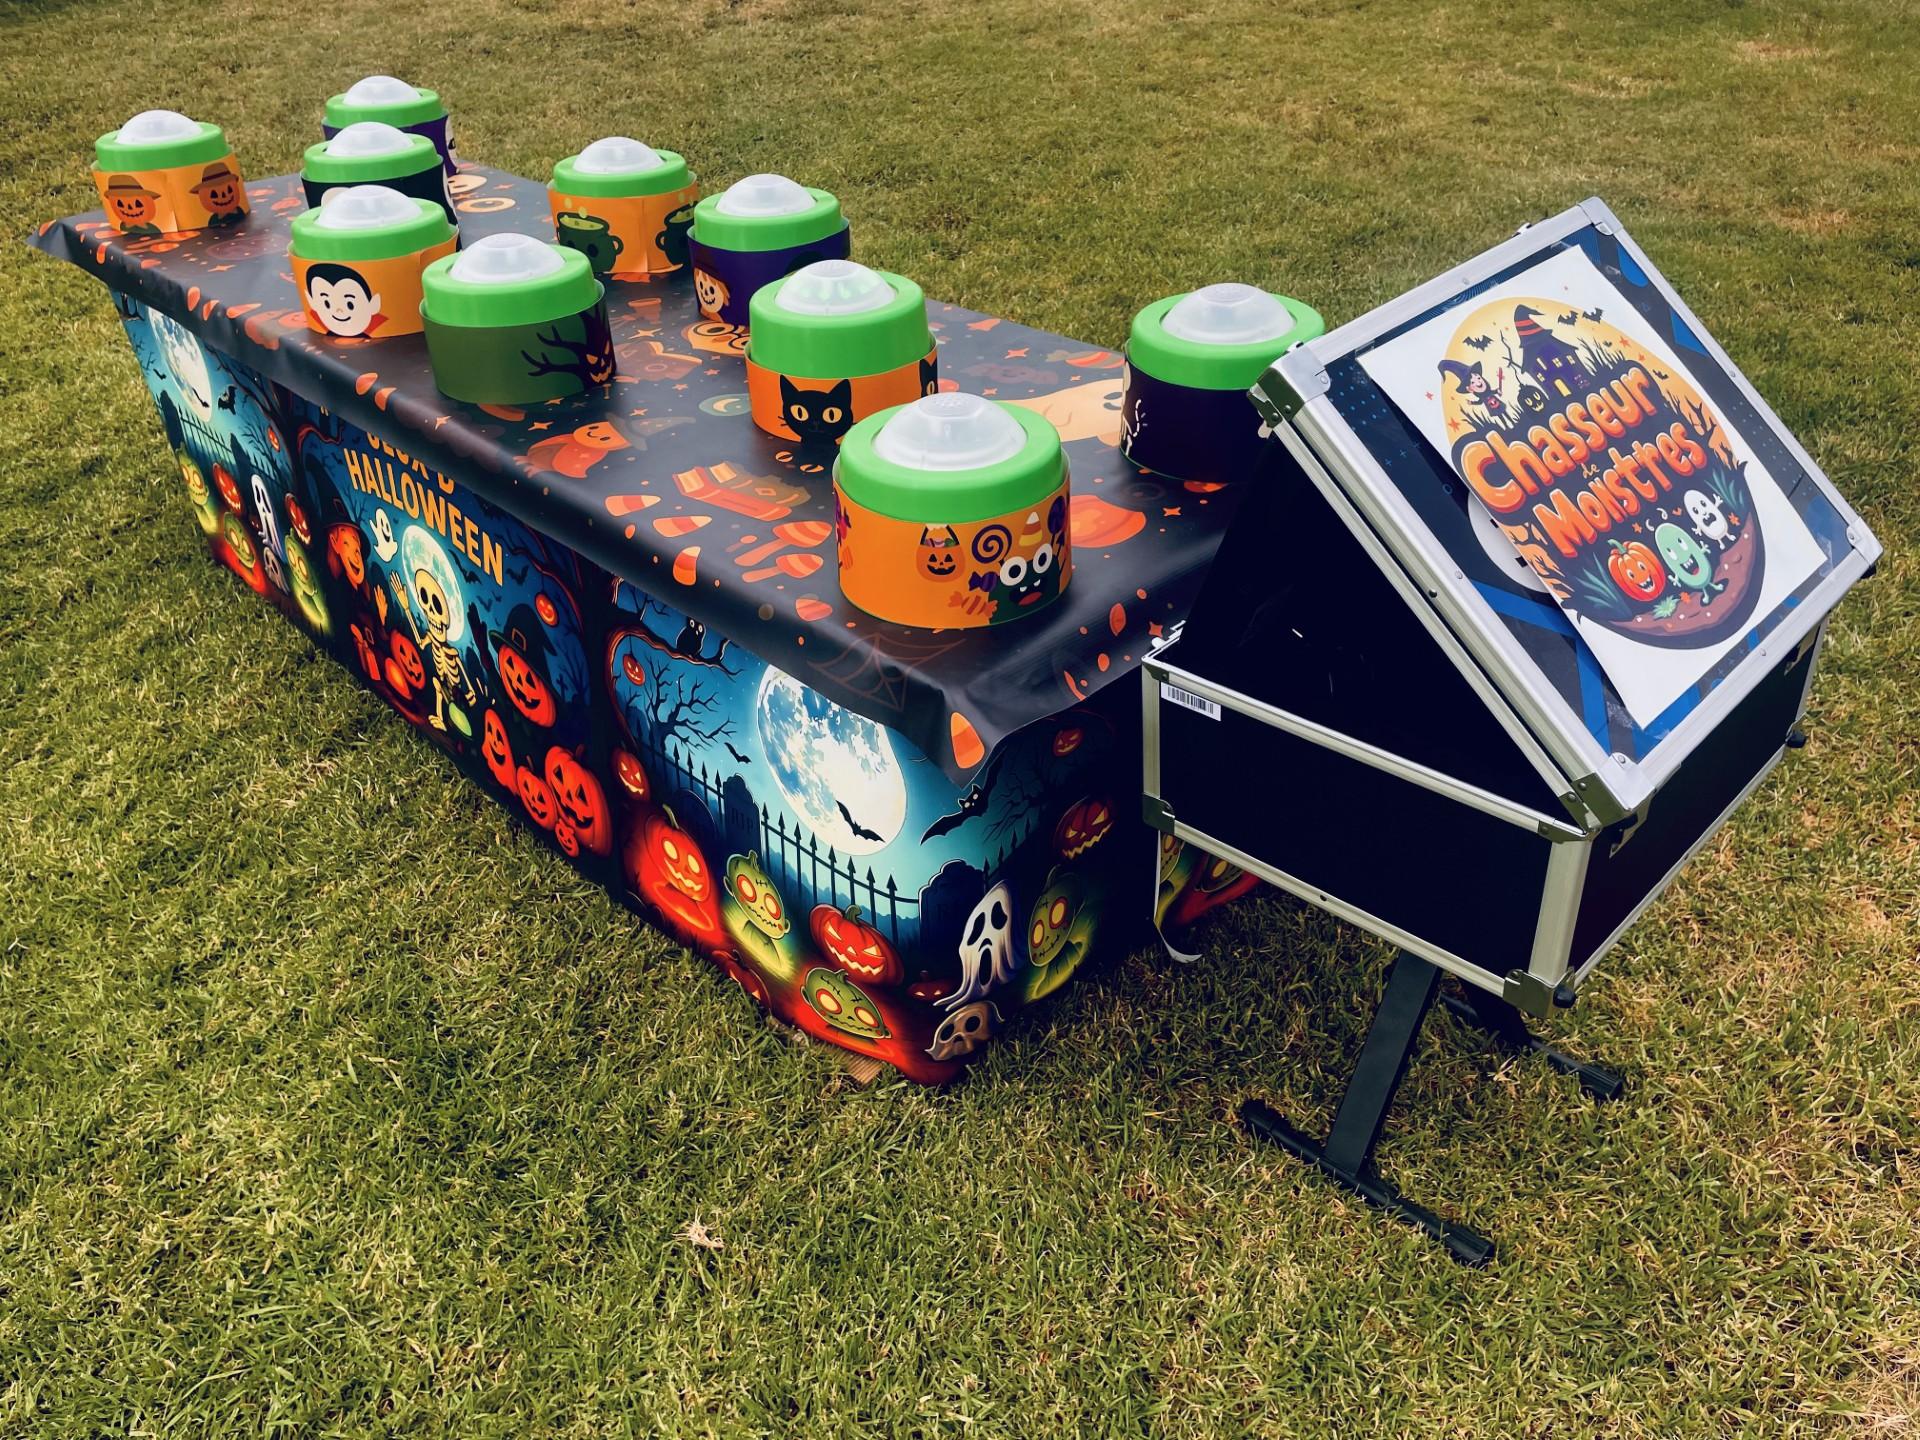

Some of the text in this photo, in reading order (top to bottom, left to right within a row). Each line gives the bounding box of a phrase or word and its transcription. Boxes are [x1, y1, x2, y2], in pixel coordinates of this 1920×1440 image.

[1461, 366, 1656, 513] Chasseur
[1532, 422, 1708, 558] Monstres
[1581, 462, 1600, 479] de
[343, 447, 503, 587] HALLOWEEN
